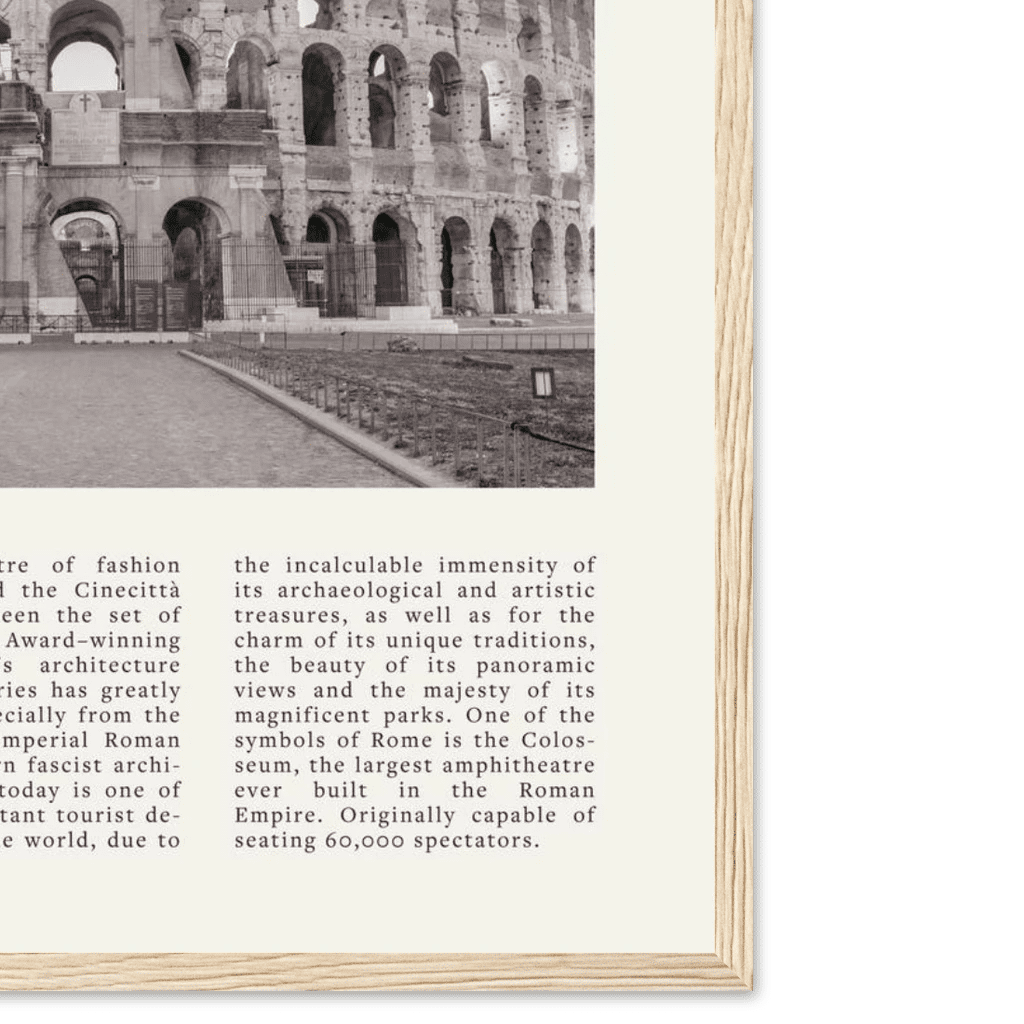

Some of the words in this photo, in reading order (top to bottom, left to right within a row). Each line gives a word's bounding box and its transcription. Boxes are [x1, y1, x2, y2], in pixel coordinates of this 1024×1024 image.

[52, 555, 76, 574] of
[97, 555, 180, 574] fashion
[234, 555, 270, 574] the
[286, 555, 423, 574] incalculable
[439, 556, 558, 579] immensity
[573, 555, 597, 574] of
[21, 580, 57, 598] the
[74, 580, 180, 599] Cinecittà
[235, 581, 263, 598] its
[278, 580, 442, 604] archaeological
[457, 580, 497, 598] and
[512, 581, 595, 598] artistic
[234, 609, 348, 626] treasures,
[365, 610, 387, 624] as
[405, 605, 451, 624] well
[469, 610, 491, 624] as
[509, 605, 542, 624] for
[559, 605, 595, 624] the
[234, 630, 303, 649] charm
[314, 630, 338, 649] of
[347, 631, 375, 649] its
[386, 631, 463, 654] unique
[473, 630, 595, 651] traditions,
[234, 655, 270, 673] the
[290, 655, 366, 679] beauty
[385, 655, 410, 673] of
[428, 656, 456, 673] its
[476, 656, 595, 679] panoramic
[51, 680, 87, 699] has
[101, 680, 181, 704] greatly
[78, 705, 131, 724] from
[144, 705, 180, 723] the
[235, 705, 370, 729] magnificent
[383, 705, 451, 729] parks.
[466, 707, 510, 724] One
[524, 705, 548, 724] of
[559, 705, 595, 724] the
[105, 732, 180, 748] Roman
[28, 755, 101, 774] fascist
[113, 755, 180, 773] archi-
[235, 760, 299, 776] seum,
[309, 755, 345, 774] the
[355, 755, 432, 779] largest
[442, 755, 595, 779] amphitheatre
[73, 781, 91, 798] is
[105, 785, 145, 798] one
[158, 780, 183, 798] of
[234, 785, 282, 798] ever
[313, 780, 367, 798] built
[399, 781, 420, 798] in
[452, 780, 487, 799] the
[520, 782, 594, 798] Roman
[56, 806, 134, 823] tourist
[145, 805, 180, 823] de-
[235, 806, 323, 829] Empire.
[340, 805, 455, 829] Originally
[471, 805, 556, 829] capable
[573, 805, 597, 823] of
[24, 830, 96, 851] world,
[107, 830, 147, 849] due
[158, 834, 180, 848] to
[234, 831, 316, 854] seating
[325, 831, 404, 851] 60,000
[414, 834, 539, 854] spectators.
